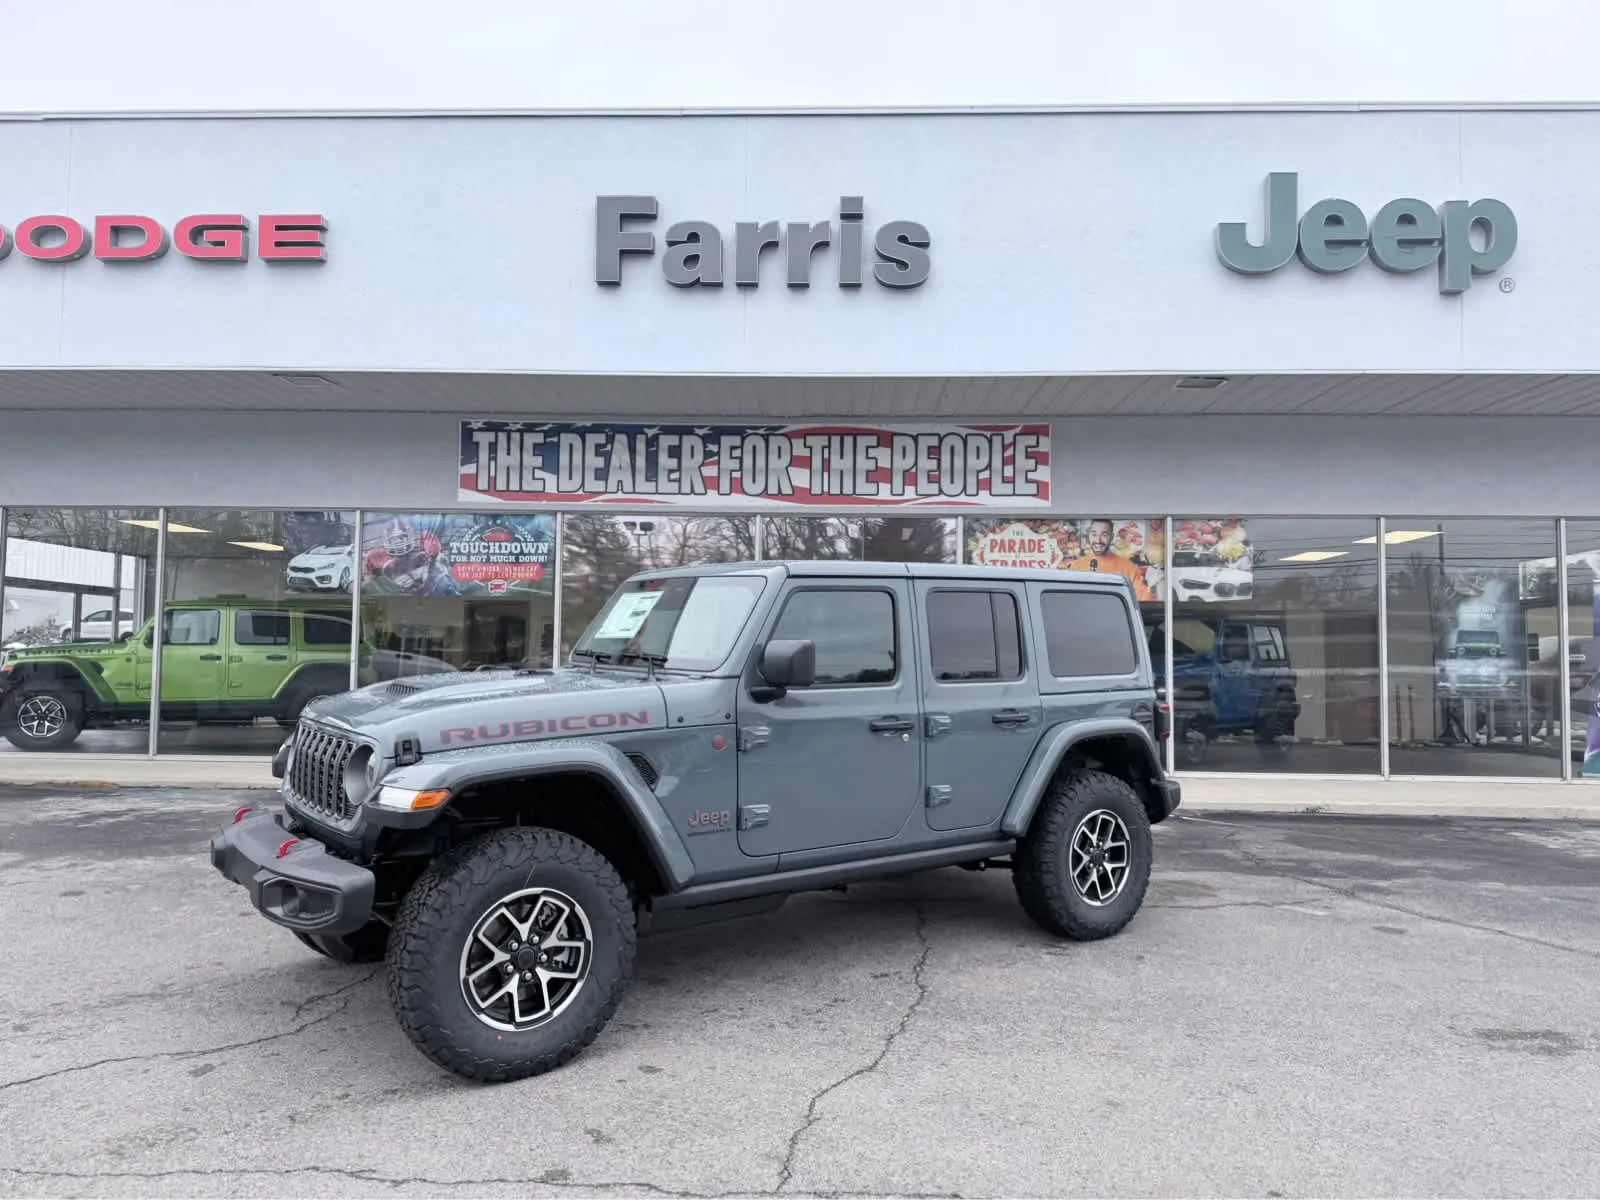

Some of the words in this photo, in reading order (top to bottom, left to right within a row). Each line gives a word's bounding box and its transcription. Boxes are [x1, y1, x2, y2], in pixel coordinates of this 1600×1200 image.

[0, 214, 328, 264] ODGE
[594, 195, 931, 289] Farris
[1214, 171, 1519, 296] Jeep
[471, 430, 546, 493] THE
[556, 431, 707, 495] DEALER
[718, 433, 794, 496] FOR
[803, 433, 880, 497] THE
[890, 432, 1040, 497] PEOPLE
[449, 541, 549, 554] TOUCHDOWN
[989, 538, 1047, 554] PARADE
[439, 710, 649, 745] RUBICON
[687, 809, 730, 827] Jeep
